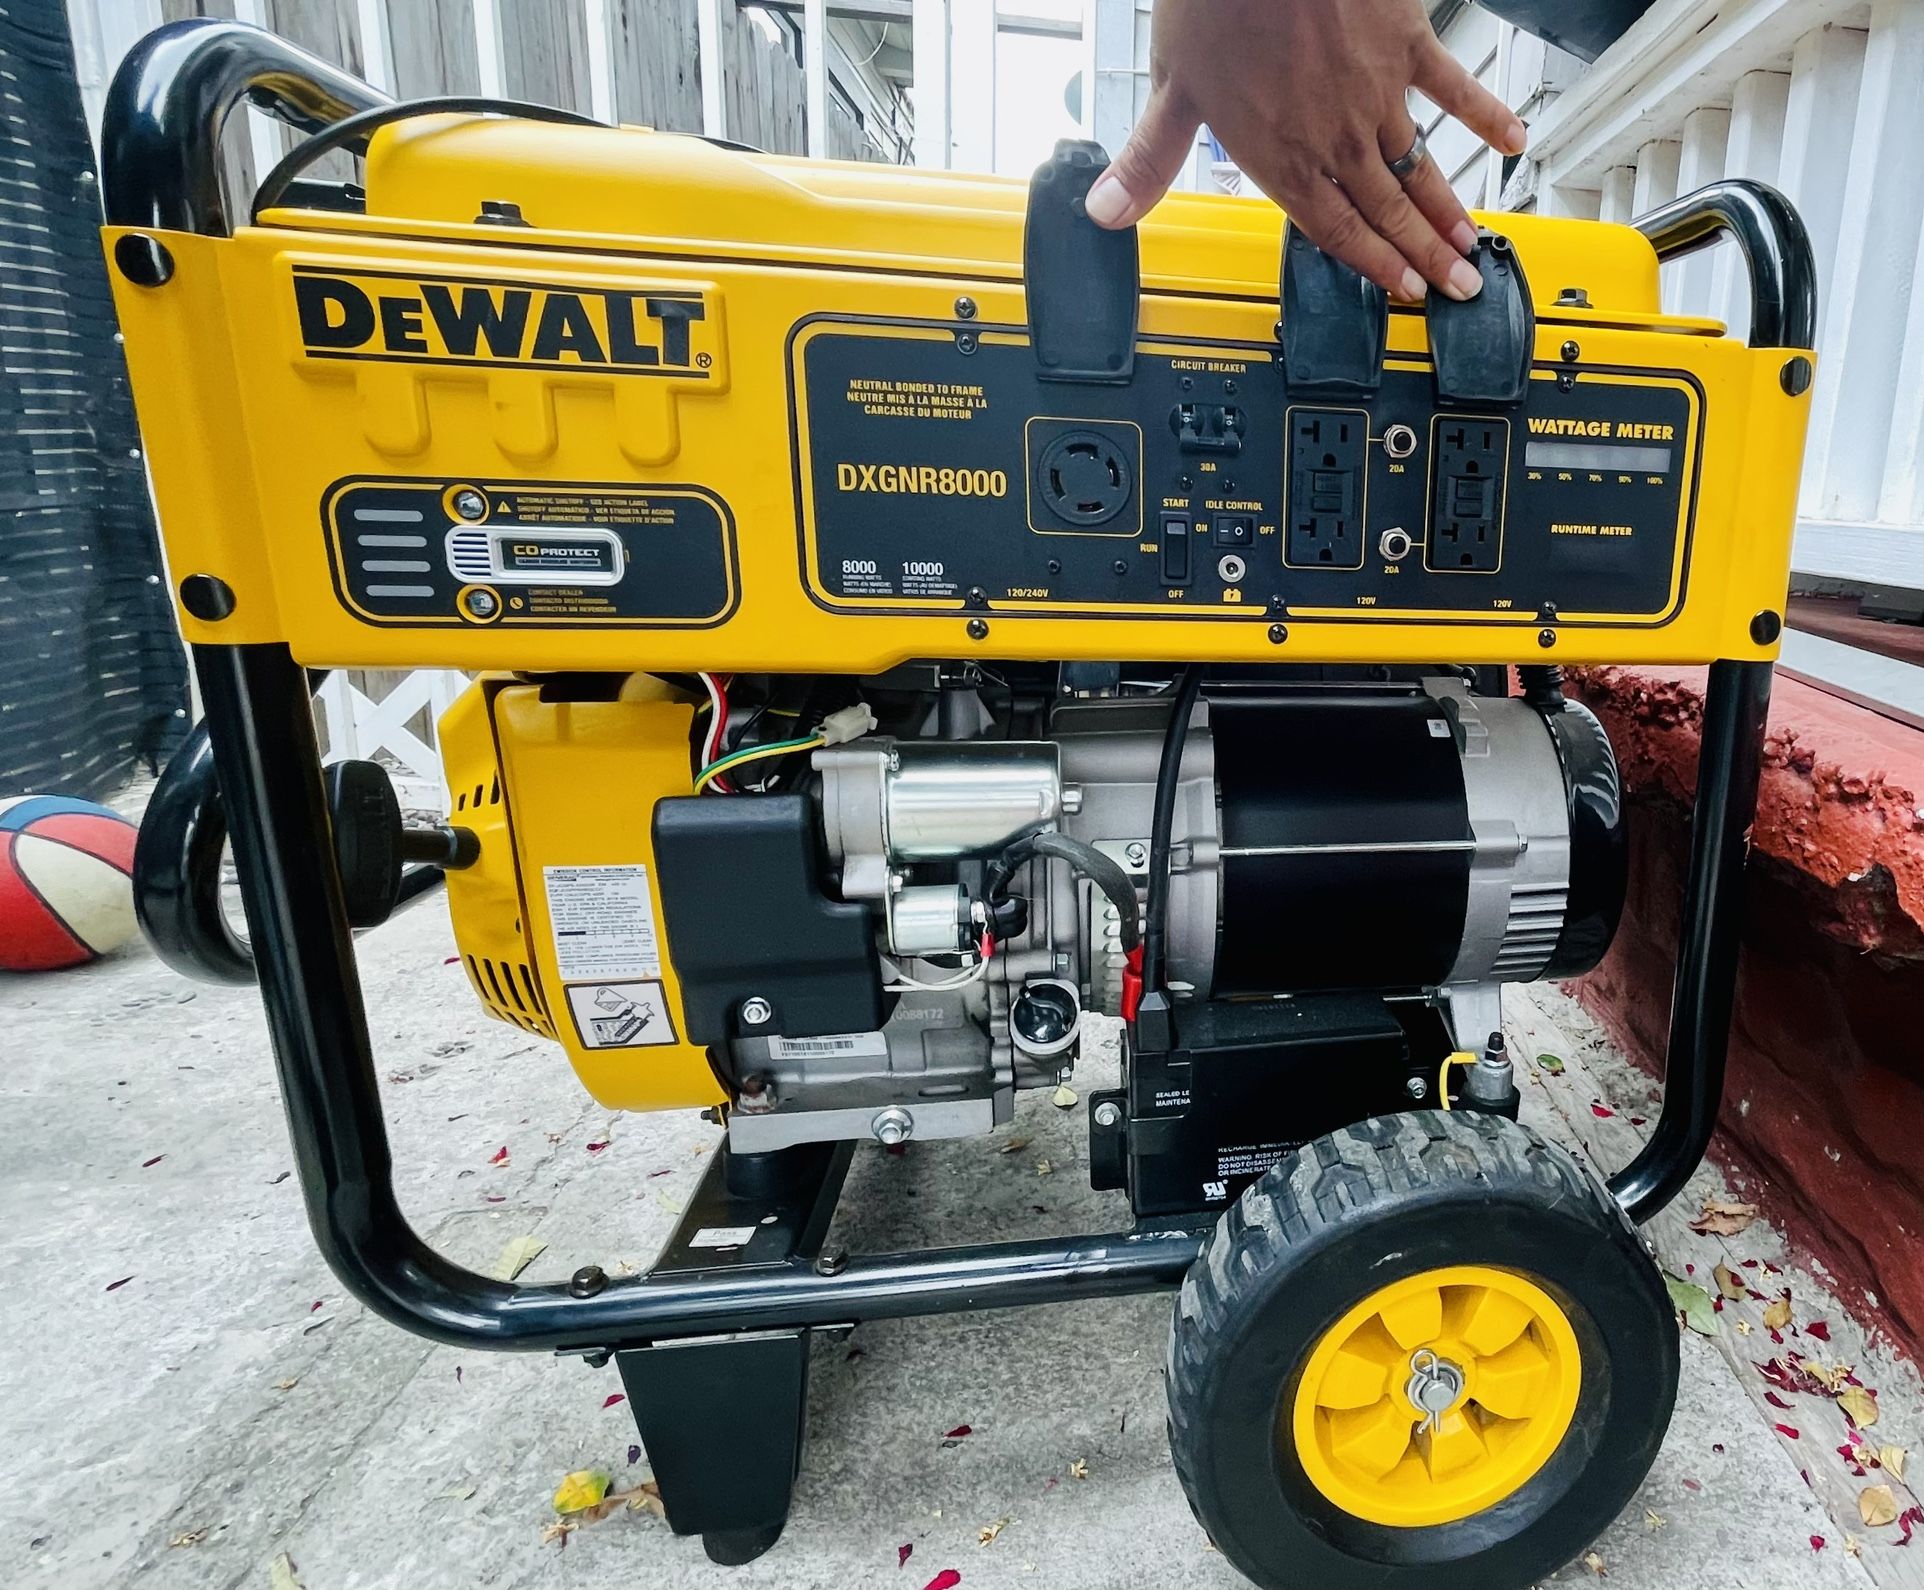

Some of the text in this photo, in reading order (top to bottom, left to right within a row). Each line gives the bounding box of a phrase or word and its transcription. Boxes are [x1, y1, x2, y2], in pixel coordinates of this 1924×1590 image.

[1171, 360, 1246, 373] CIRCUIT BREAKER
[850, 380, 983, 396] NEUTRAL BONDED TO FRAME
[846, 391, 988, 408] NEUTRE MIS À LA MASSE À LA
[864, 404, 972, 420] CARCASSE DU MOTEUR
[1527, 418, 1674, 441] WATTAGE METER
[1200, 462, 1216, 472] 30A
[1389, 464, 1404, 473] 20A
[837, 463, 1008, 497] DXGNR8000
[1528, 472, 1542, 480] 30%
[1558, 472, 1572, 481] 50%
[1588, 474, 1602, 482] 70%
[1647, 476, 1664, 485] 100%
[1162, 498, 1189, 508] START
[1206, 500, 1263, 511] IDLE CONTROL
[1195, 524, 1208, 533] ON
[1260, 526, 1276, 534] OFF
[1550, 524, 1632, 536] RUNTIME METER
[540, 548, 600, 556] PROTECT
[1140, 544, 1158, 552] RUN
[842, 560, 876, 574] 8000
[902, 562, 944, 576] 10000
[1384, 566, 1400, 574] 20A
[1006, 588, 1049, 598] 120/240V
[1168, 590, 1184, 598] OFF
[1356, 596, 1376, 606] 120V
[1494, 600, 1512, 608] 120V
[1156, 1090, 1180, 1098] SEALED
[1218, 1154, 1252, 1163] WARNING
